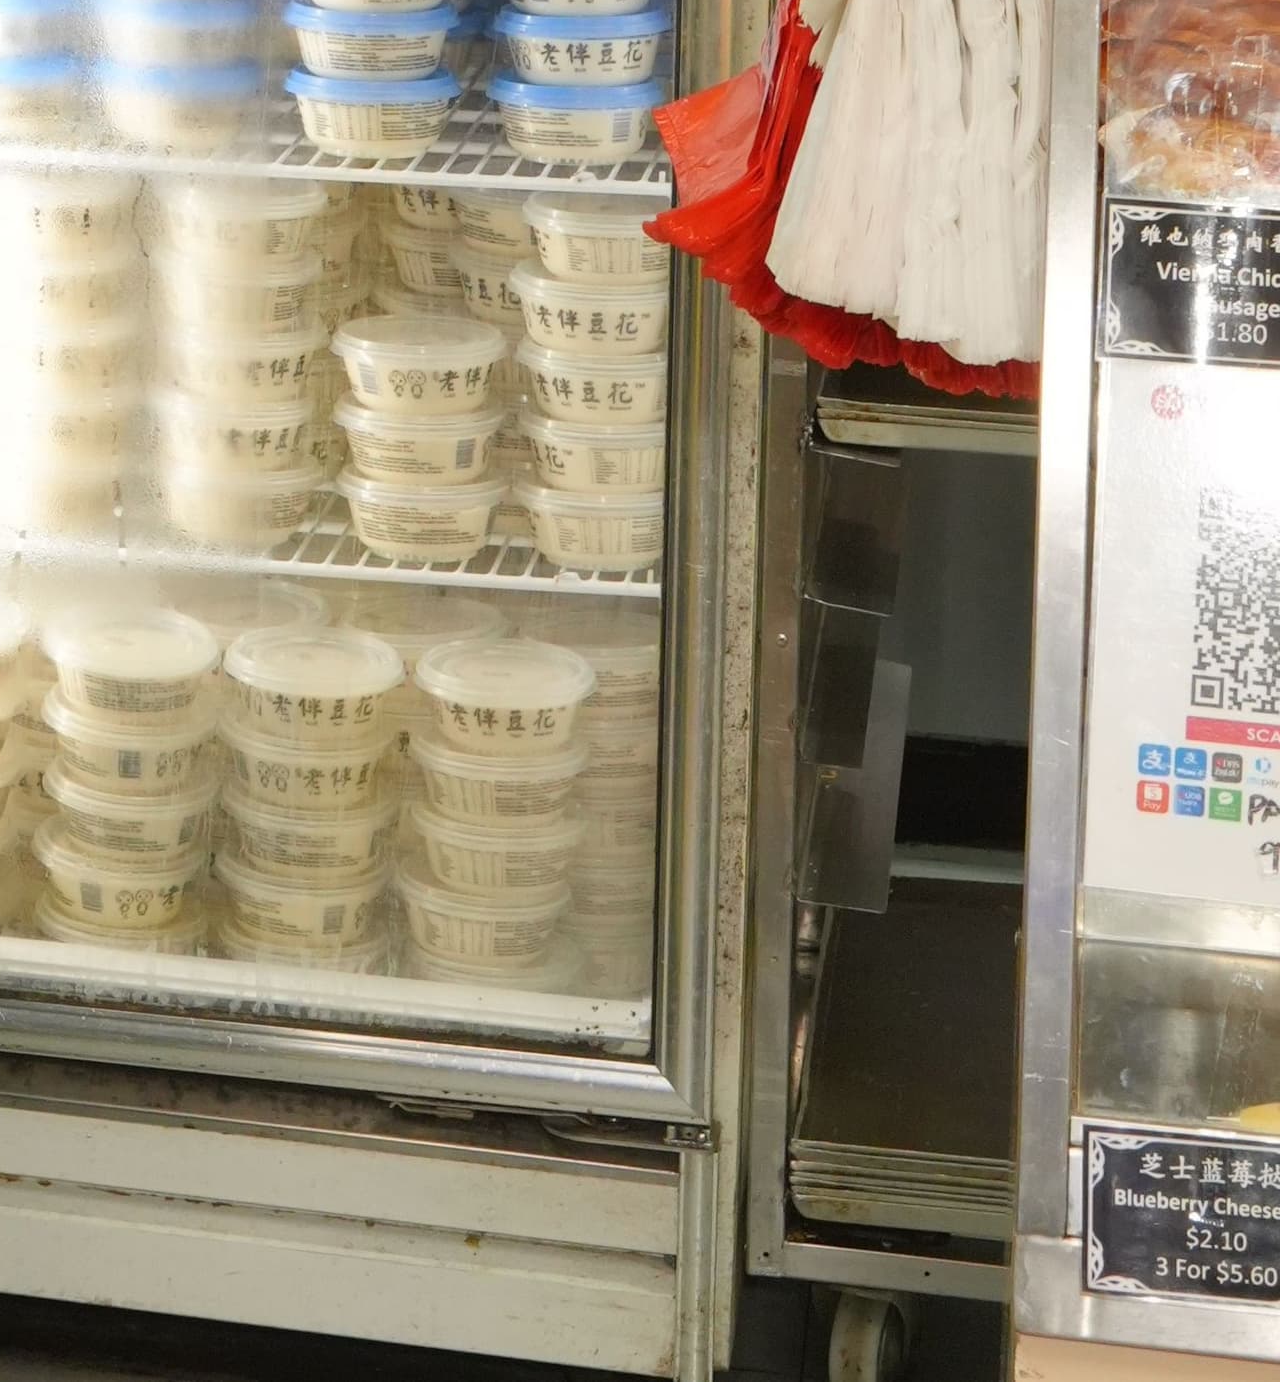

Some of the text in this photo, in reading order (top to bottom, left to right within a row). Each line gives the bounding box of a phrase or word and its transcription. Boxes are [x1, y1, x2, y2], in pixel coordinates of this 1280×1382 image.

[1114, 1188, 1208, 1217] Blueberry
[1186, 1229, 1247, 1252] $2.10
[1156, 1257, 1277, 1286] 3 For $5.60
